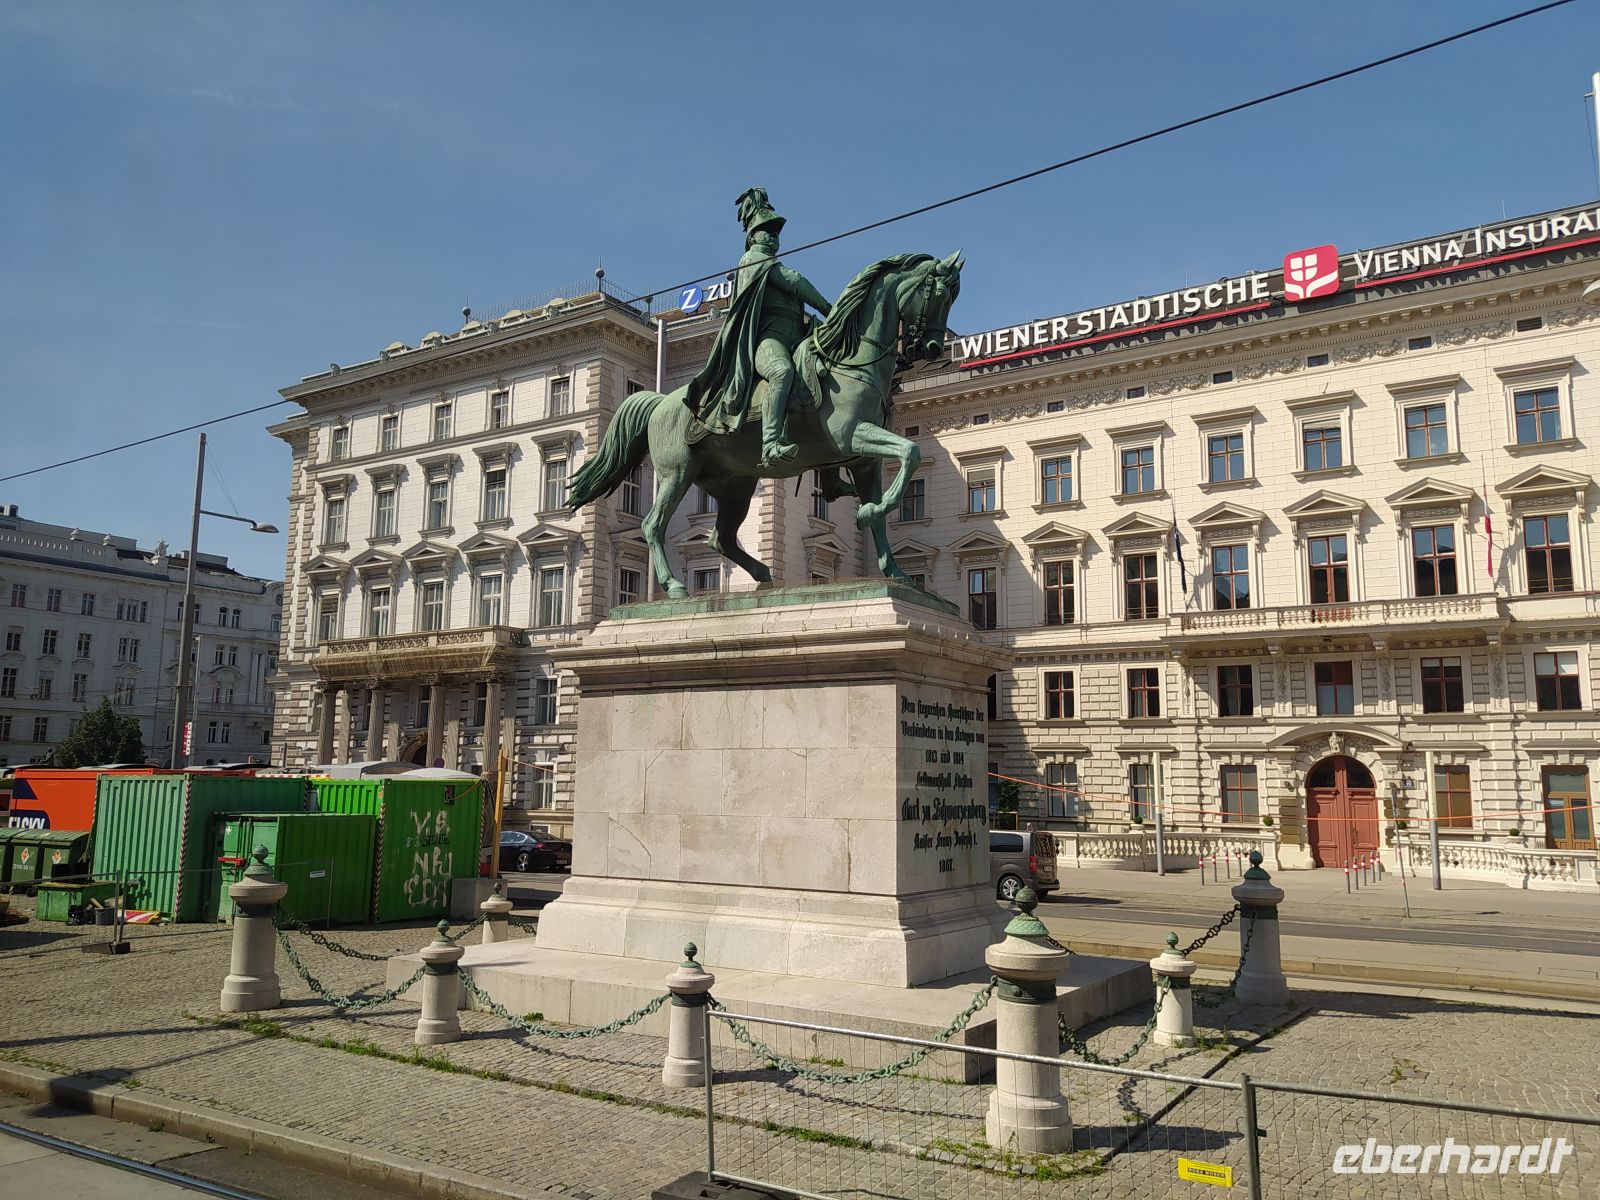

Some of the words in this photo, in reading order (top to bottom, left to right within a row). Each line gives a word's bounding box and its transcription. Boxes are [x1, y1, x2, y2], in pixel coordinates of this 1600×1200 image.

[681, 288, 700, 310] Z
[961, 317, 1069, 358] WIENER
[1077, 273, 1270, 335] STÄDTISCHE
[901, 695, 915, 714] Dem
[976, 708, 985, 722] der
[937, 727, 943, 740] in
[944, 725, 954, 741] den
[925, 750, 938, 763] 1813
[940, 748, 951, 764] und
[953, 752, 964, 765] 1814
[921, 804, 931, 825] zu
[932, 797, 987, 827] Schwarzenberg
